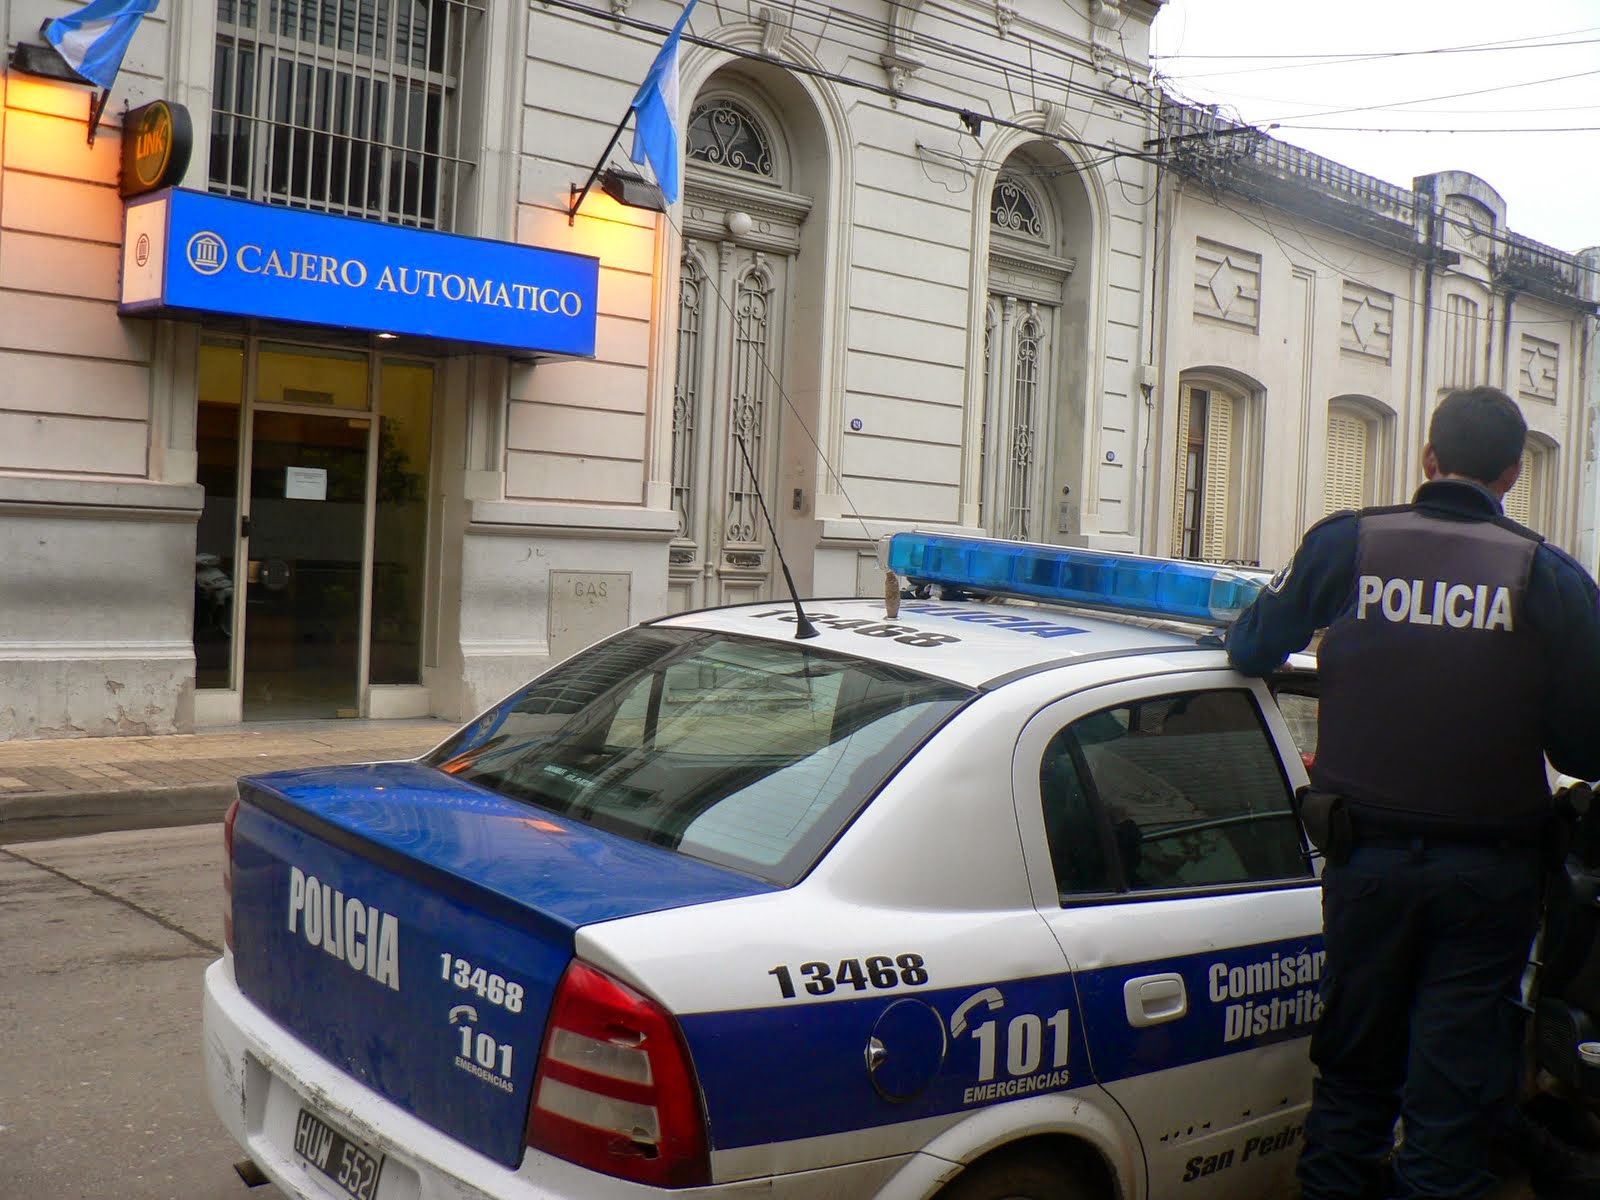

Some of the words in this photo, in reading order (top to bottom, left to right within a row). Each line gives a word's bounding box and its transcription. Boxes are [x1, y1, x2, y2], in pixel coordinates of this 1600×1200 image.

[136, 120, 168, 159] LINK
[235, 244, 368, 288] CAJERO
[375, 265, 583, 318] AUTOMATICO
[574, 580, 608, 598] GAS
[1356, 574, 1515, 632] POLICIA
[288, 865, 400, 992] POLICIA
[440, 951, 524, 1014] 13468
[767, 952, 929, 999] 13468
[453, 1055, 514, 1093] EMERGENCIAS
[458, 1024, 514, 1078] 101
[971, 1007, 1071, 1083] 101
[962, 1069, 1071, 1105] EMERGENCIAS
[296, 1111, 335, 1170] HUW
[338, 1142, 376, 1200] 552
[1182, 1148, 1235, 1182] San
[1240, 1124, 1305, 1163] Pedr
